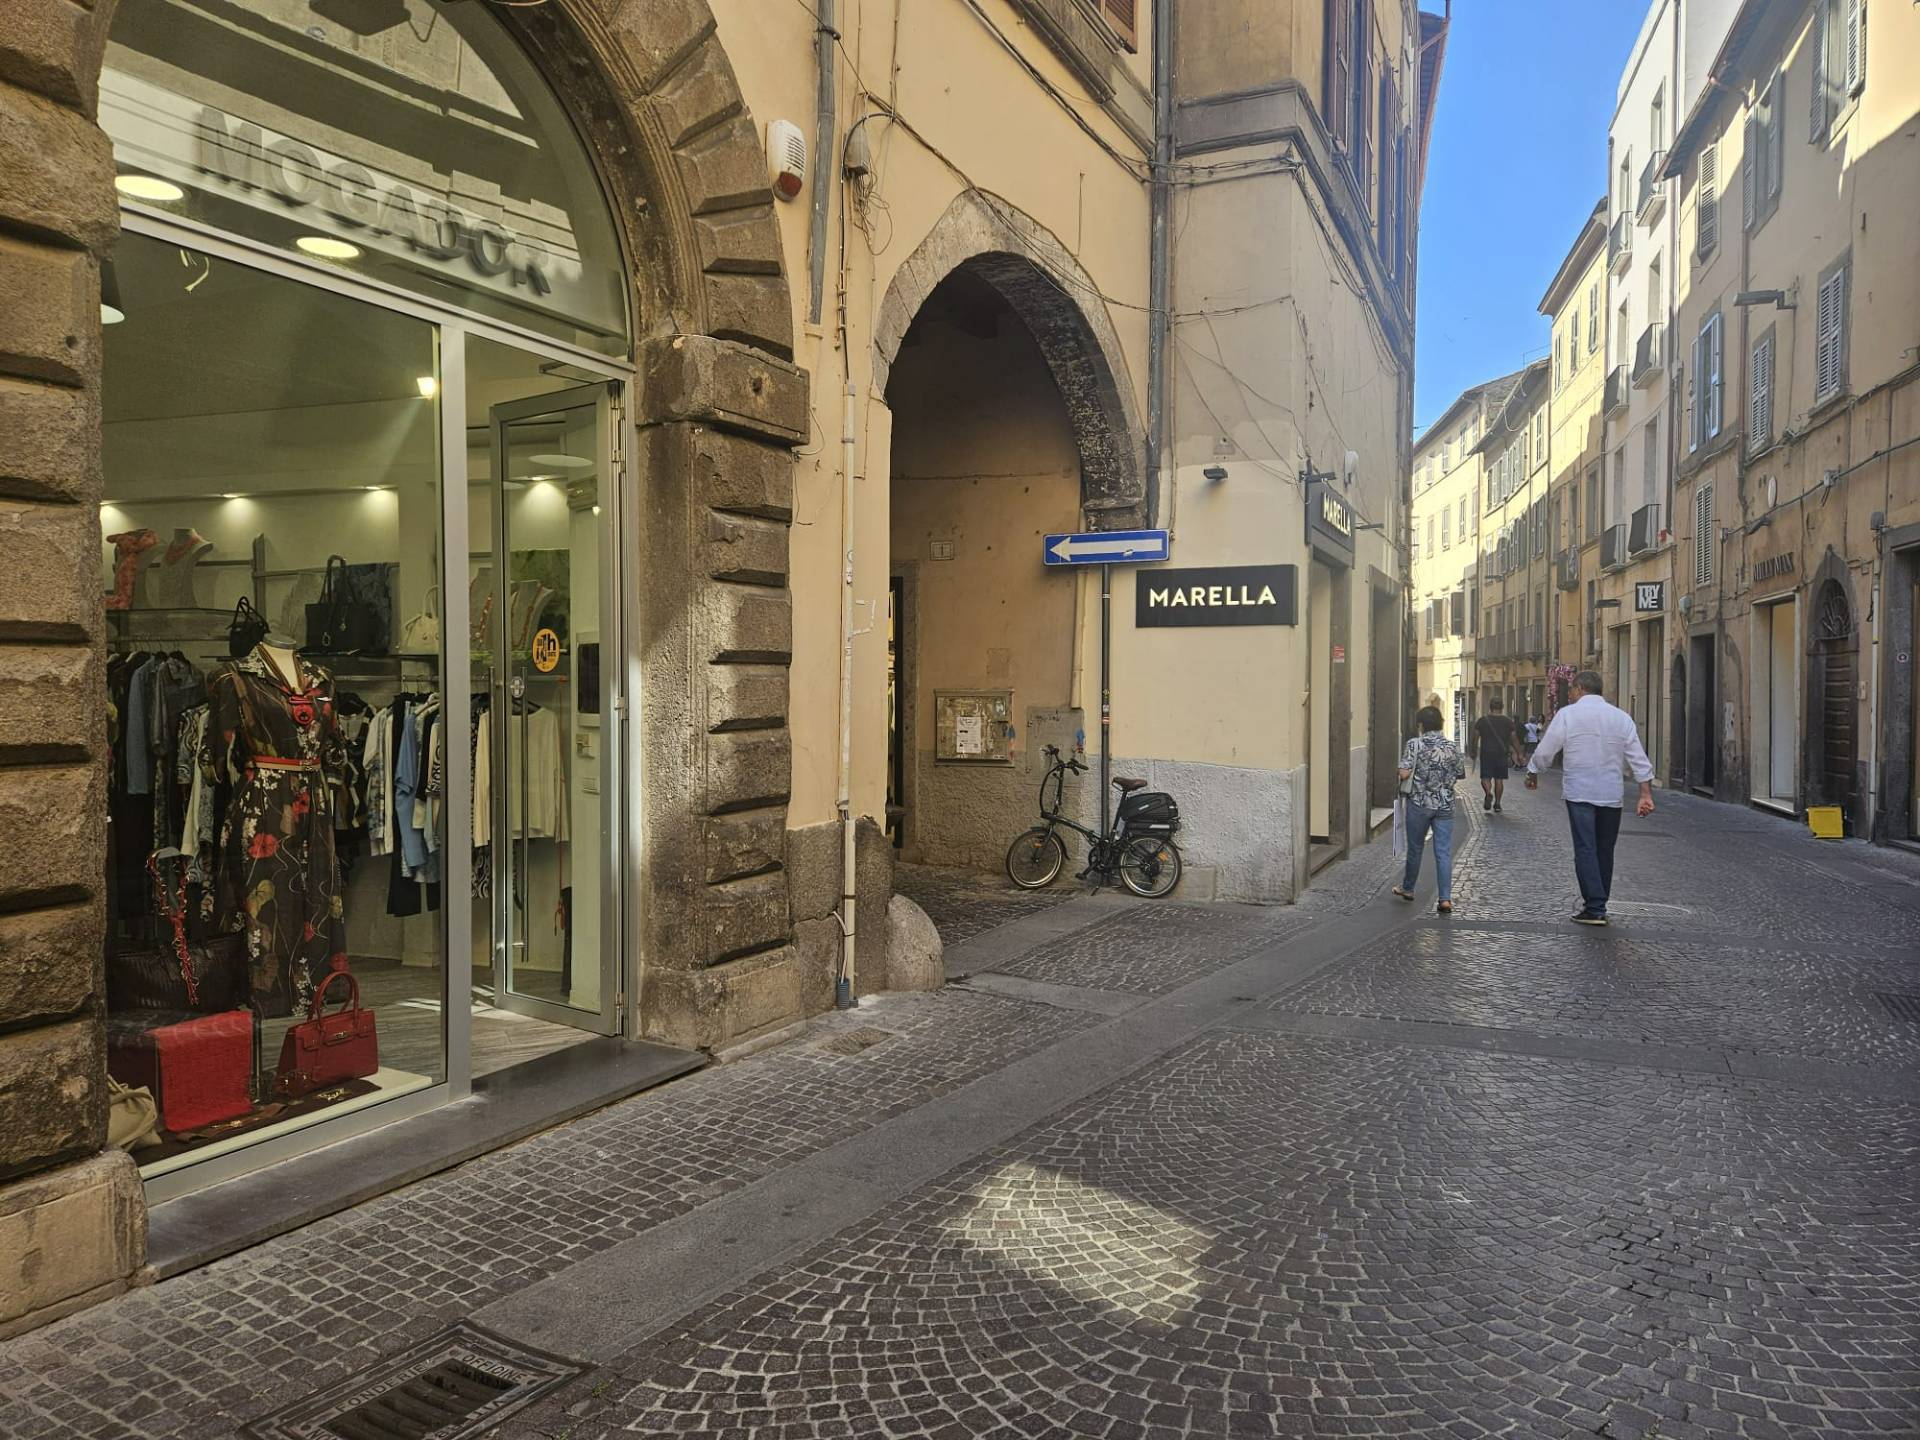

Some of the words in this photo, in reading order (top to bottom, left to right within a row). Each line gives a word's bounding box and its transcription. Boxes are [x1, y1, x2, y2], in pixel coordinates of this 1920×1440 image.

[1323, 492, 1351, 537] MARELLA
[1149, 585, 1277, 608] MARELLA
[1638, 596, 1658, 609] ME
[463, 1353, 528, 1381] OFFICINE
[335, 1363, 427, 1413] FONDERIE
